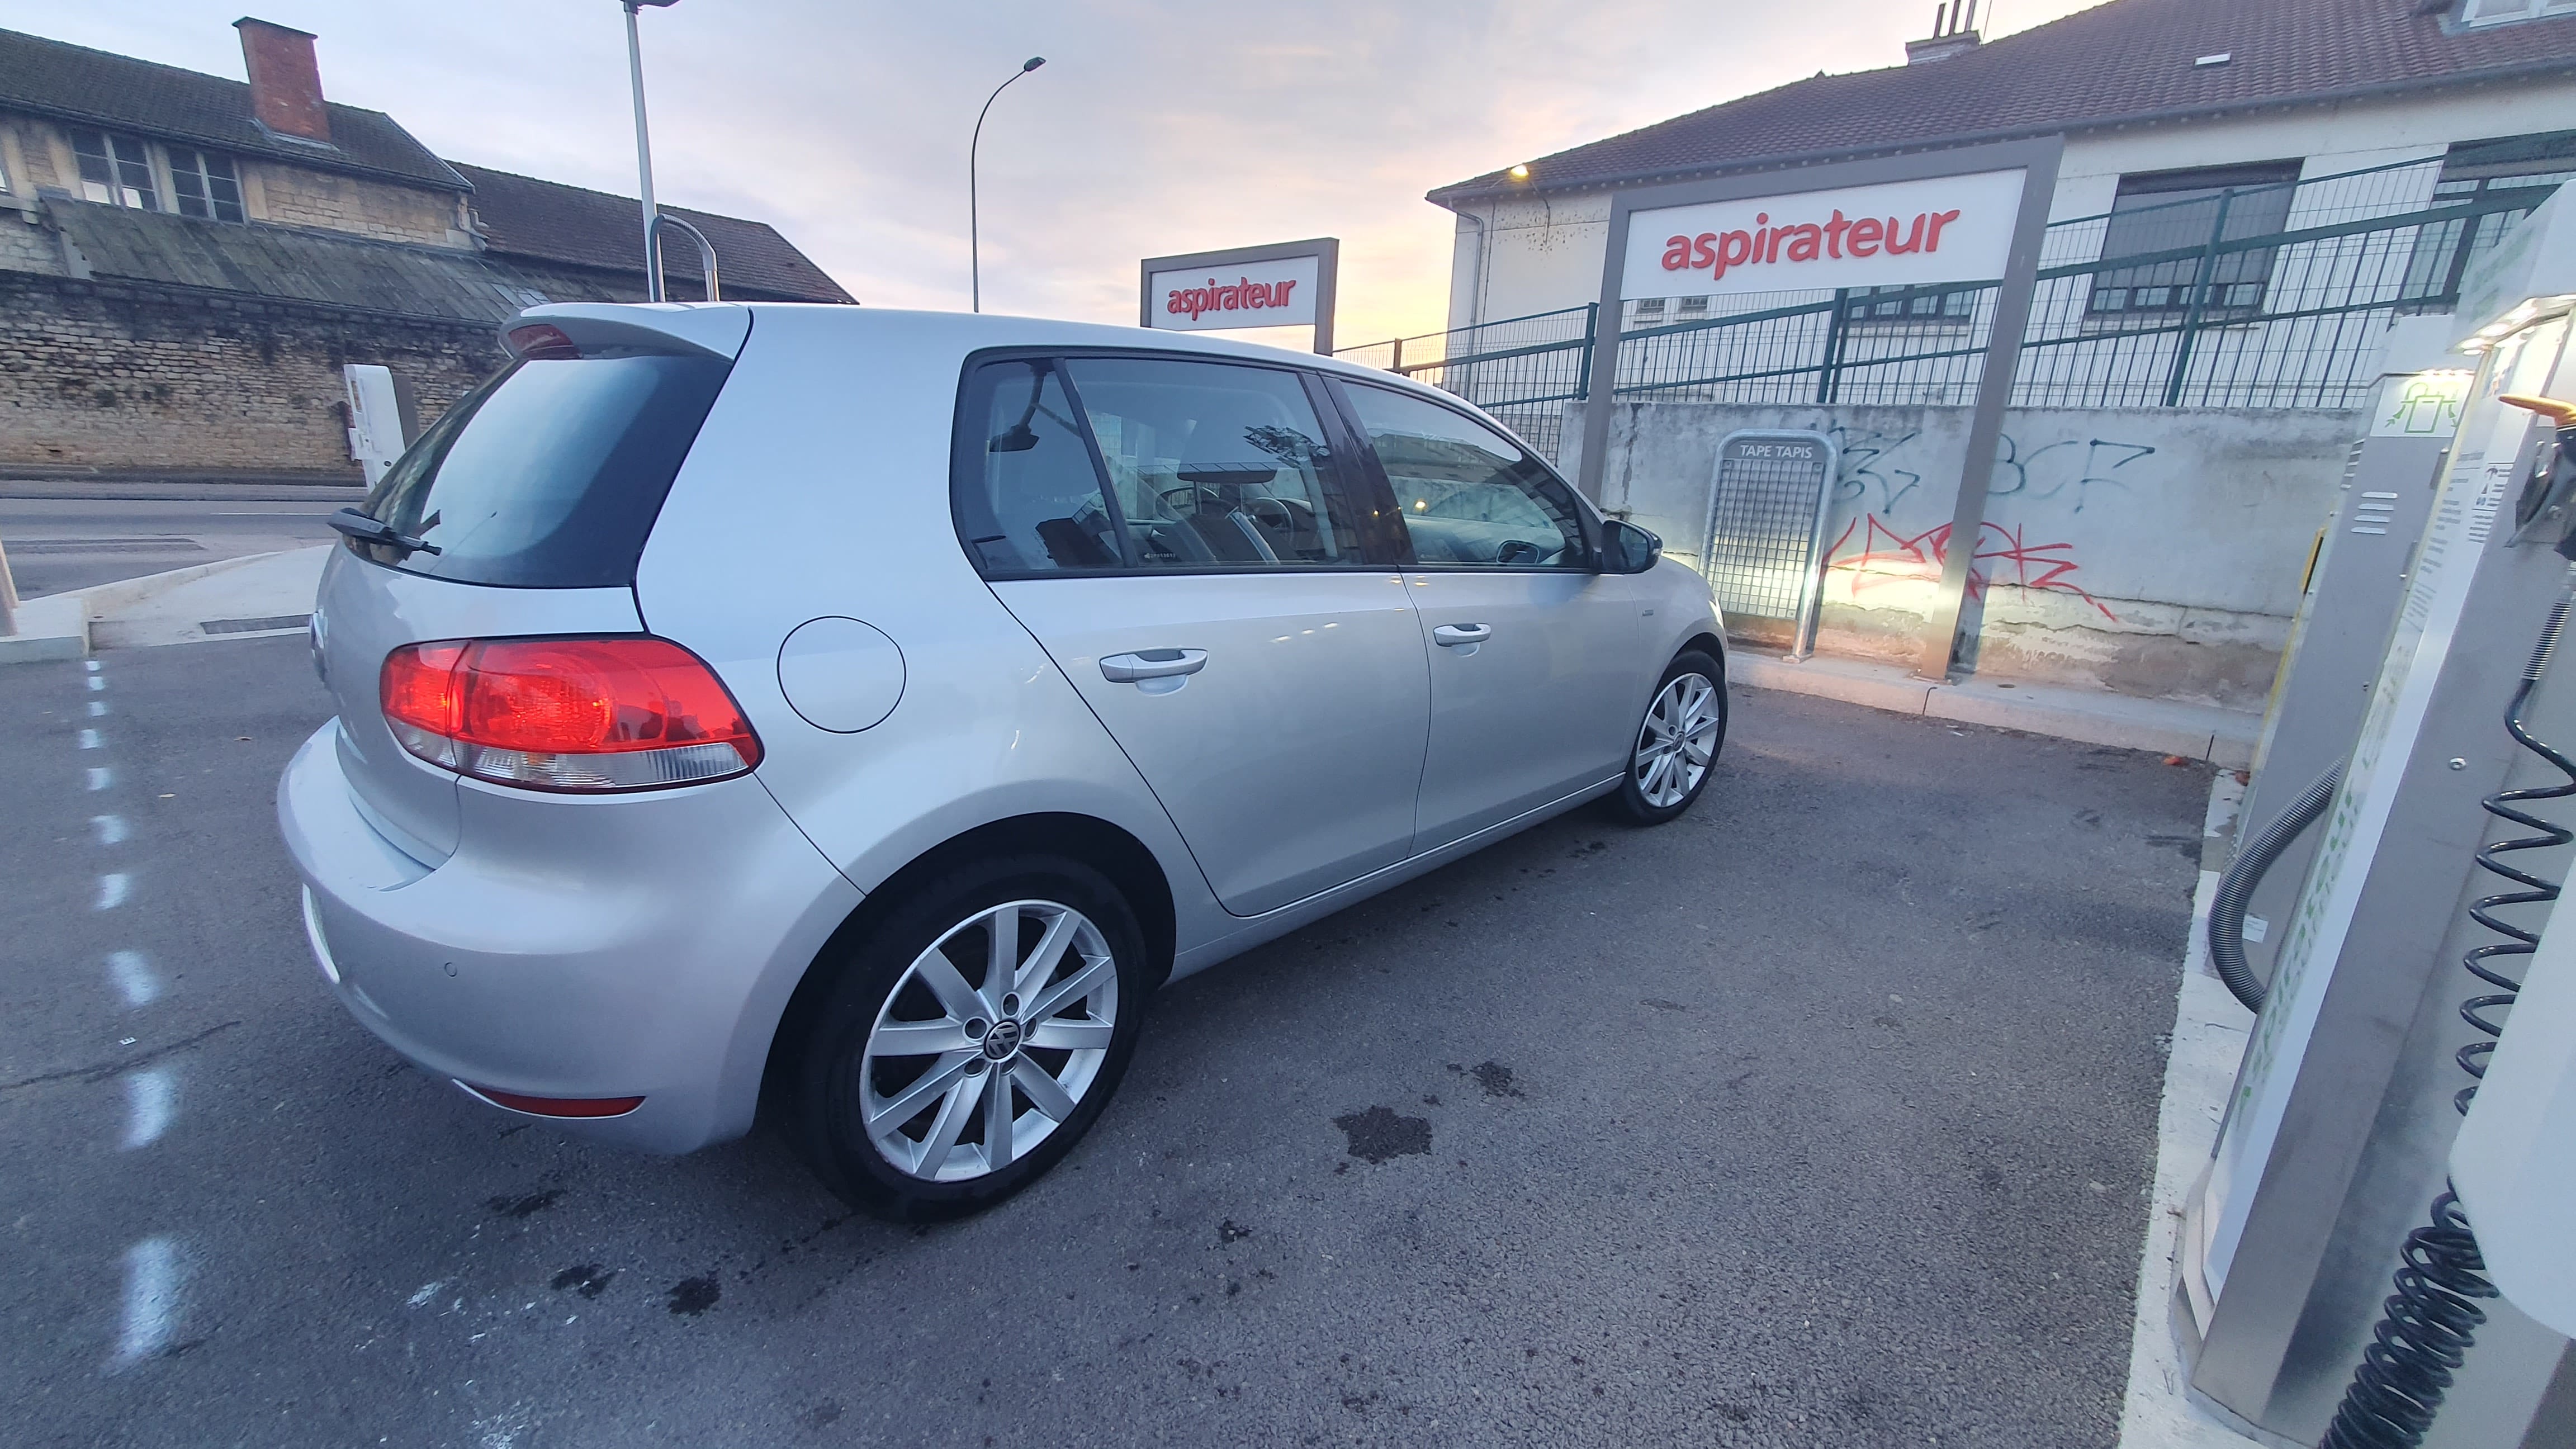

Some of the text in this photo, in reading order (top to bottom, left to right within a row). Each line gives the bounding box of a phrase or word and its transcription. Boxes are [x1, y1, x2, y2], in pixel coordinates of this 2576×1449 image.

[1661, 209, 1960, 280] aspirateur
[1167, 277, 1296, 321] aspirateur
[1740, 445, 1813, 459] TAPE TAPIS
